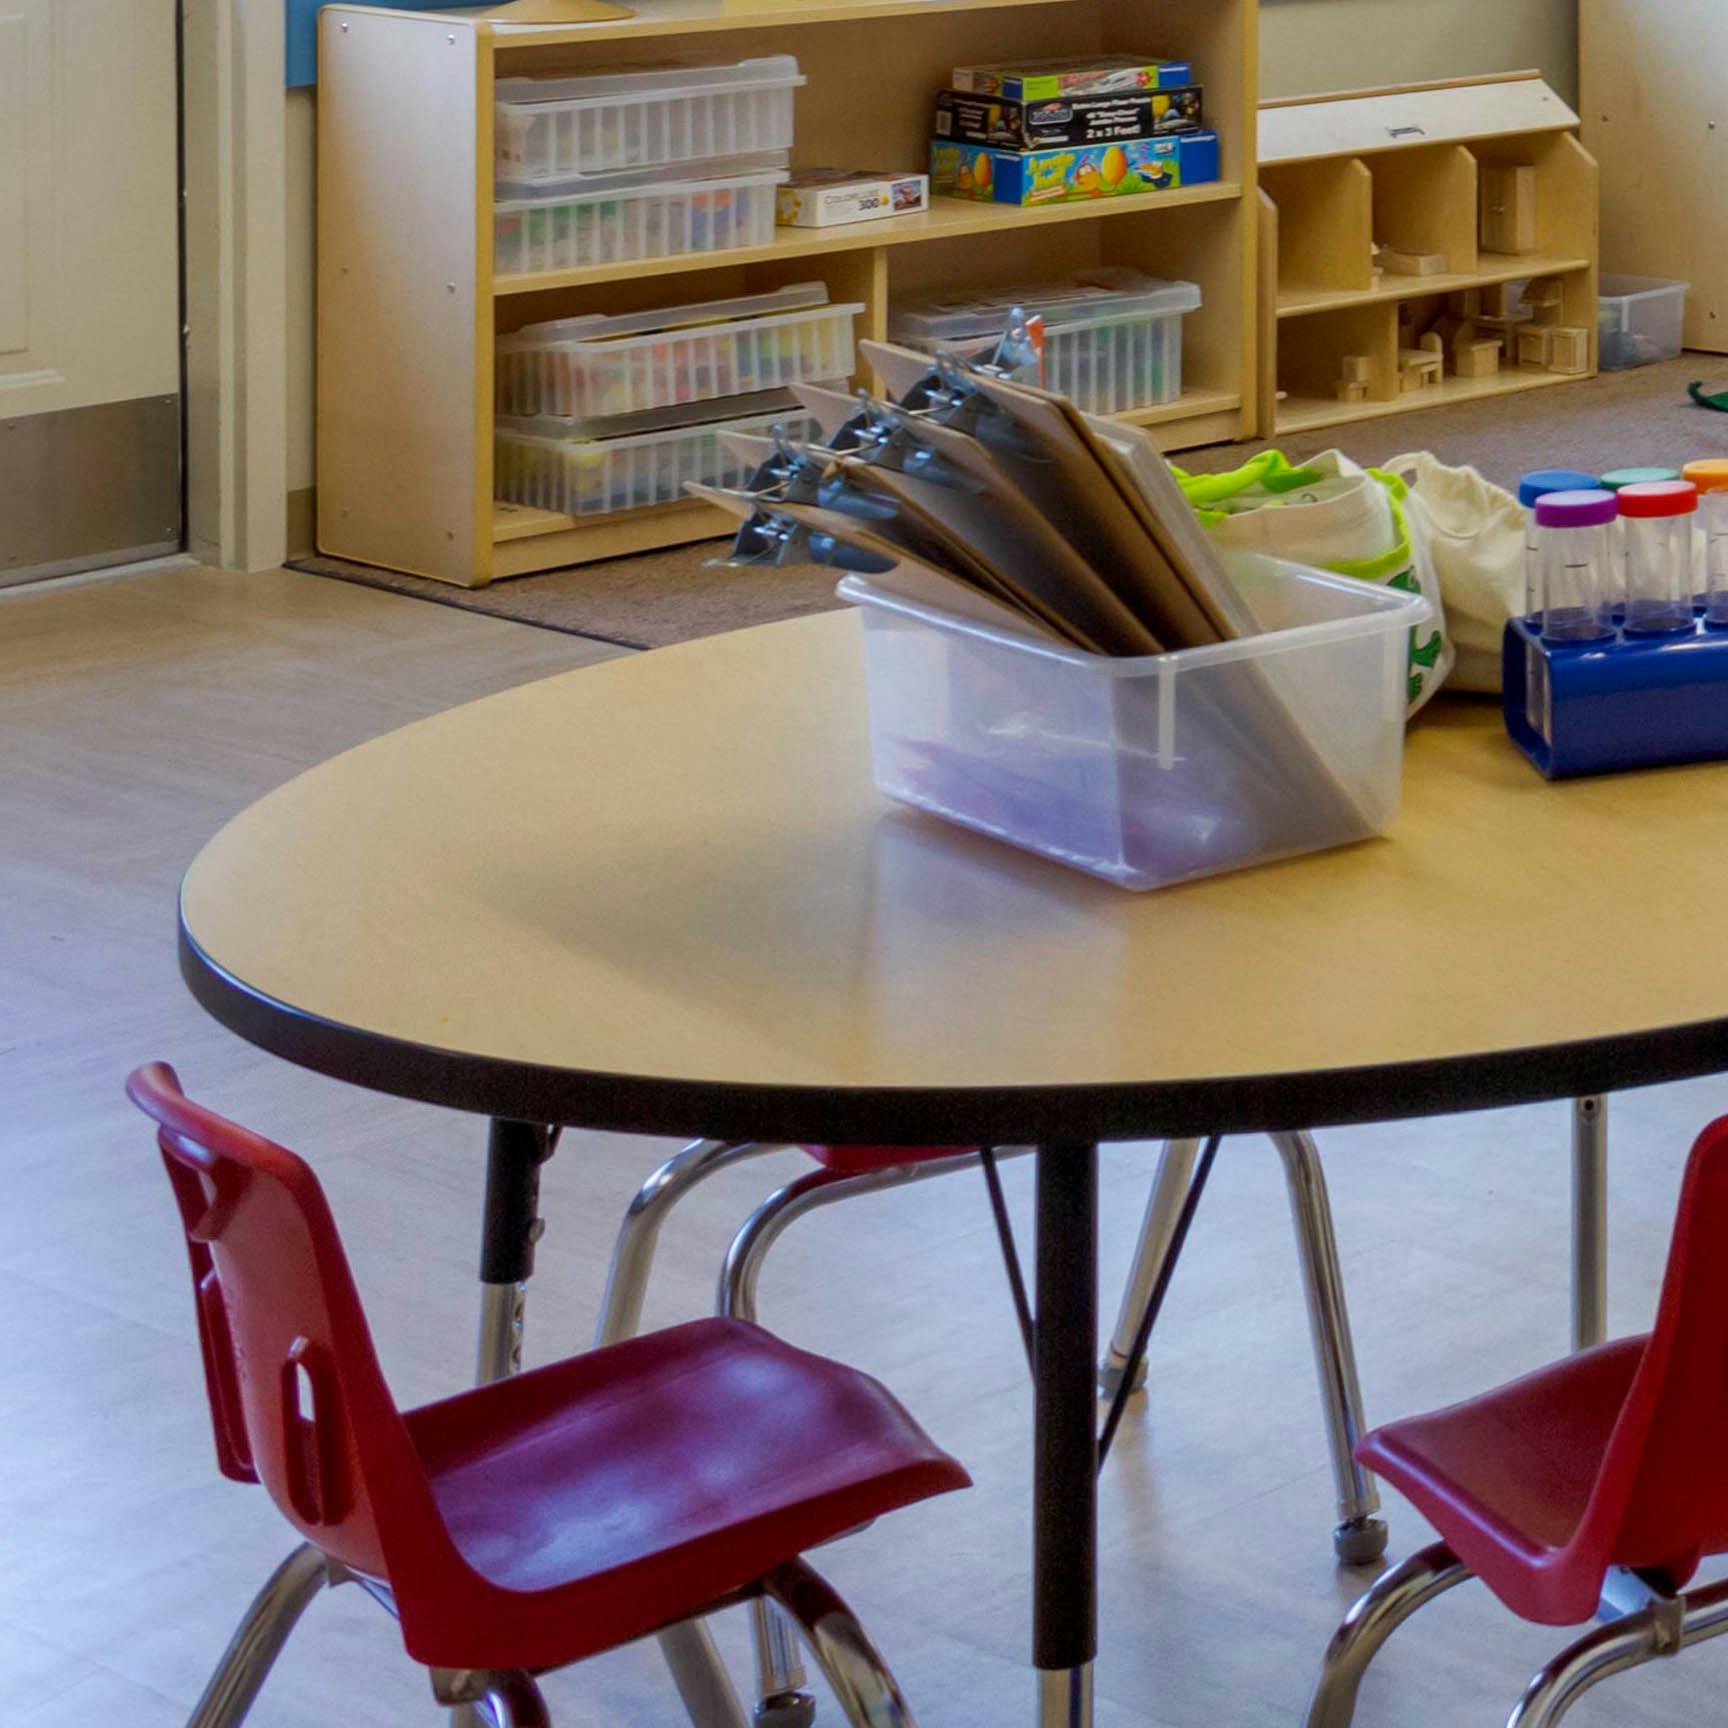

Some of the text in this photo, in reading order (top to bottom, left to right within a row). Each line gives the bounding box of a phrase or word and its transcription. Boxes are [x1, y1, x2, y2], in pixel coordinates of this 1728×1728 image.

[1086, 128, 1095, 139] 2
[1105, 127, 1113, 137] 3
[858, 197, 879, 211] 300
